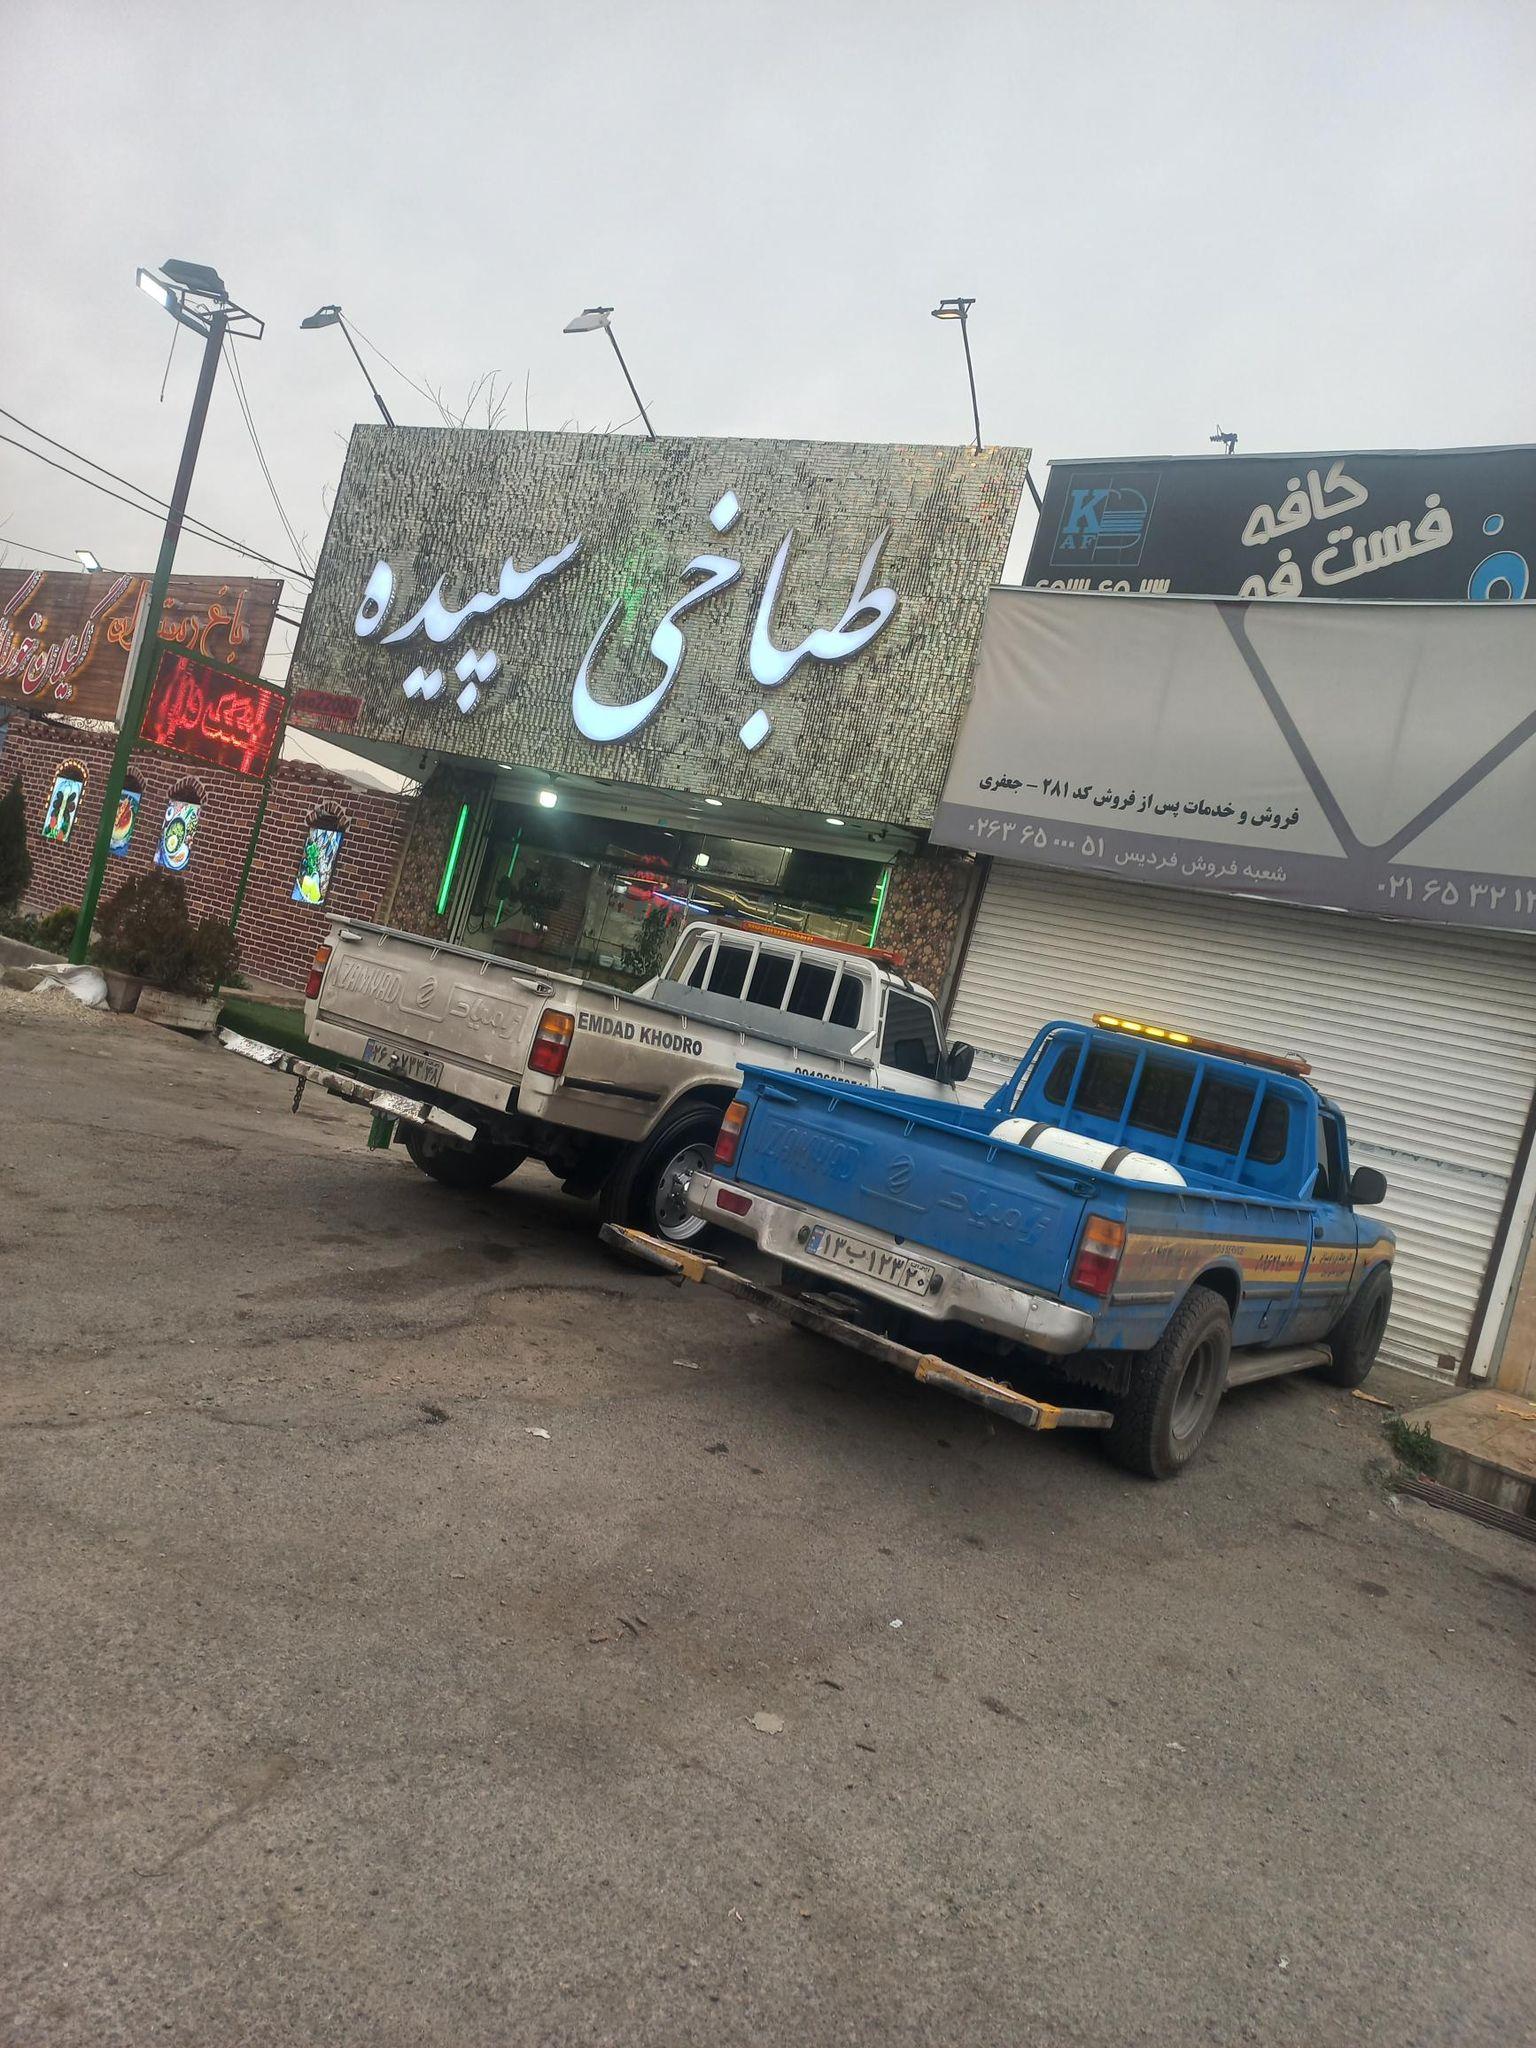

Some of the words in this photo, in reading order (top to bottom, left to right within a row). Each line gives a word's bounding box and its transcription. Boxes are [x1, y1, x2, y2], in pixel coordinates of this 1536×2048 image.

[1241, 461, 1368, 547] کافه
[1311, 494, 1453, 586] فست
[354, 532, 585, 714] سپیده
[572, 490, 897, 751] طباخی
[979, 774, 1023, 794] جعفری
[1042, 778, 1069, 798] ۲۸۱
[1072, 786, 1093, 800] کد
[1093, 789, 1137, 811] فروش
[1137, 794, 1154, 812] از
[1154, 801, 1180, 818] پس
[1183, 800, 1235, 818] خدمات
[1237, 810, 1248, 825] و
[1251, 807, 1300, 829] فروش
[1115, 851, 1178, 869] فردیس
[1181, 856, 1238, 878] فروش
[1243, 865, 1287, 882] شعبه
[577, 1012, 635, 1040] EMDAD
[639, 1025, 703, 1056] KHODRO
